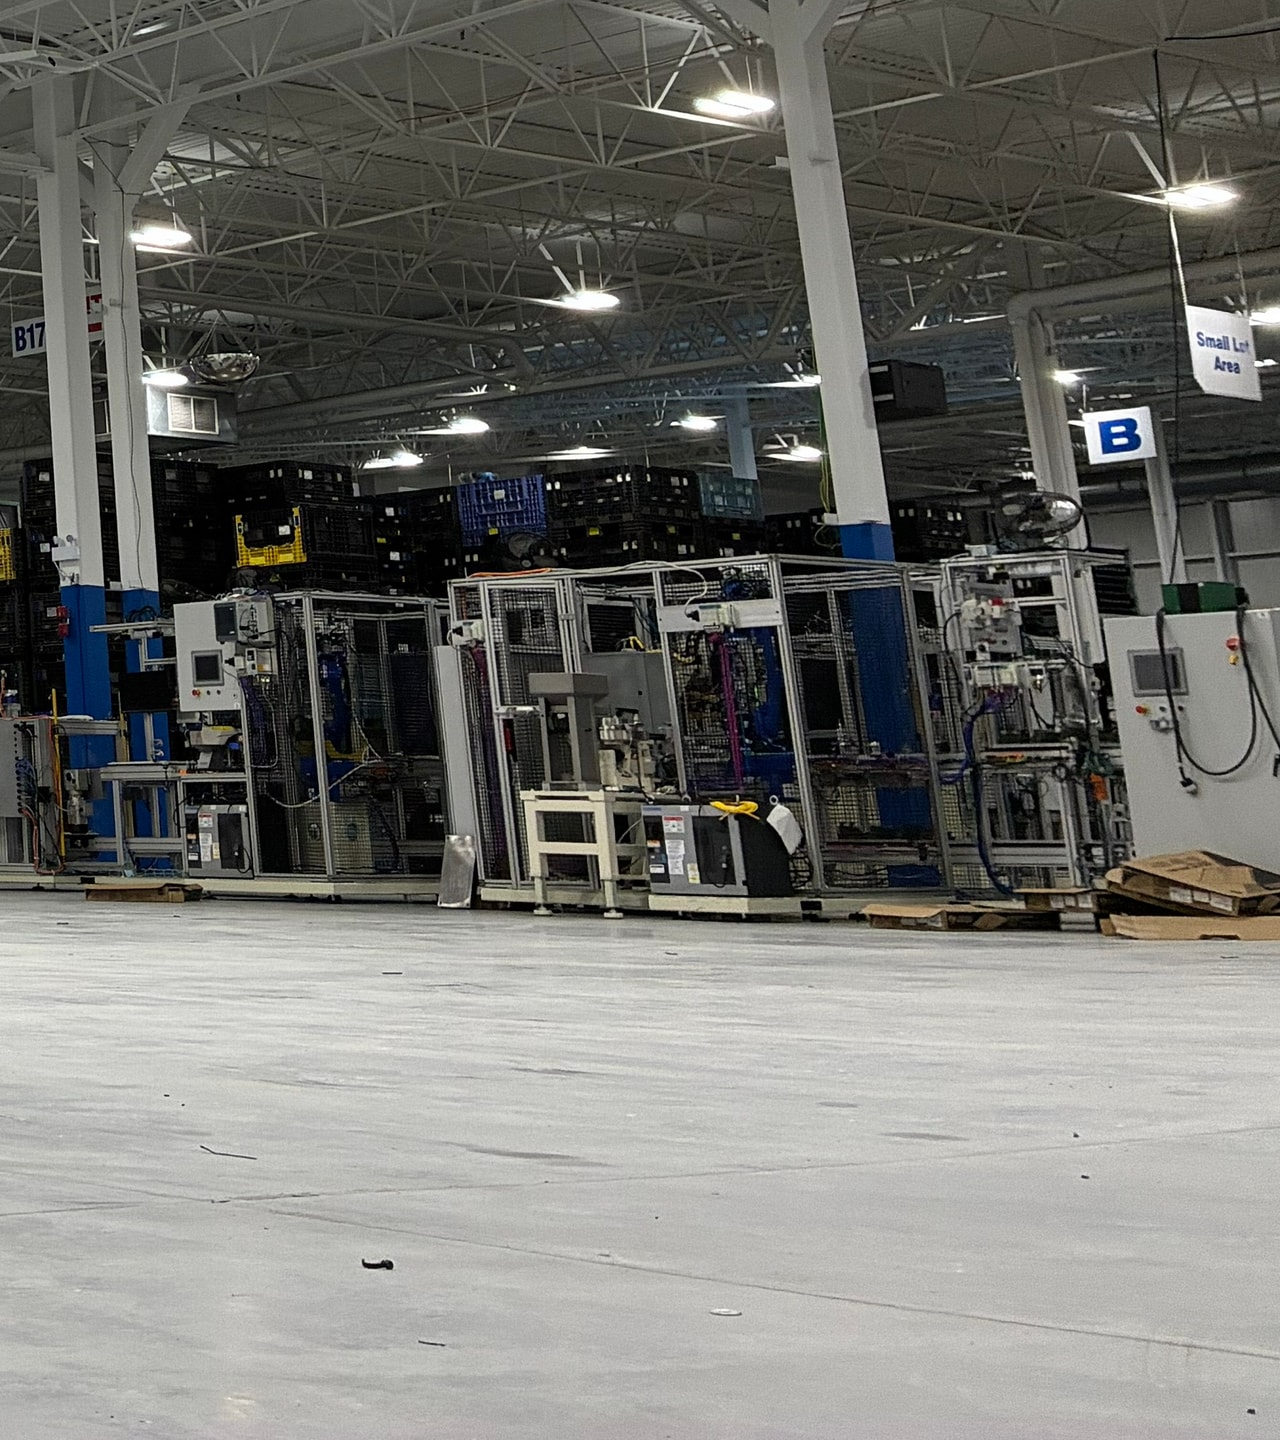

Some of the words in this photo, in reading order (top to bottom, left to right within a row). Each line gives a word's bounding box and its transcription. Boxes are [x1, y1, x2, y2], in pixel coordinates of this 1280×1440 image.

[14, 321, 46, 352] B17
[1196, 331, 1231, 351] Small
[1214, 356, 1241, 374] Area
[1098, 417, 1142, 454] B
